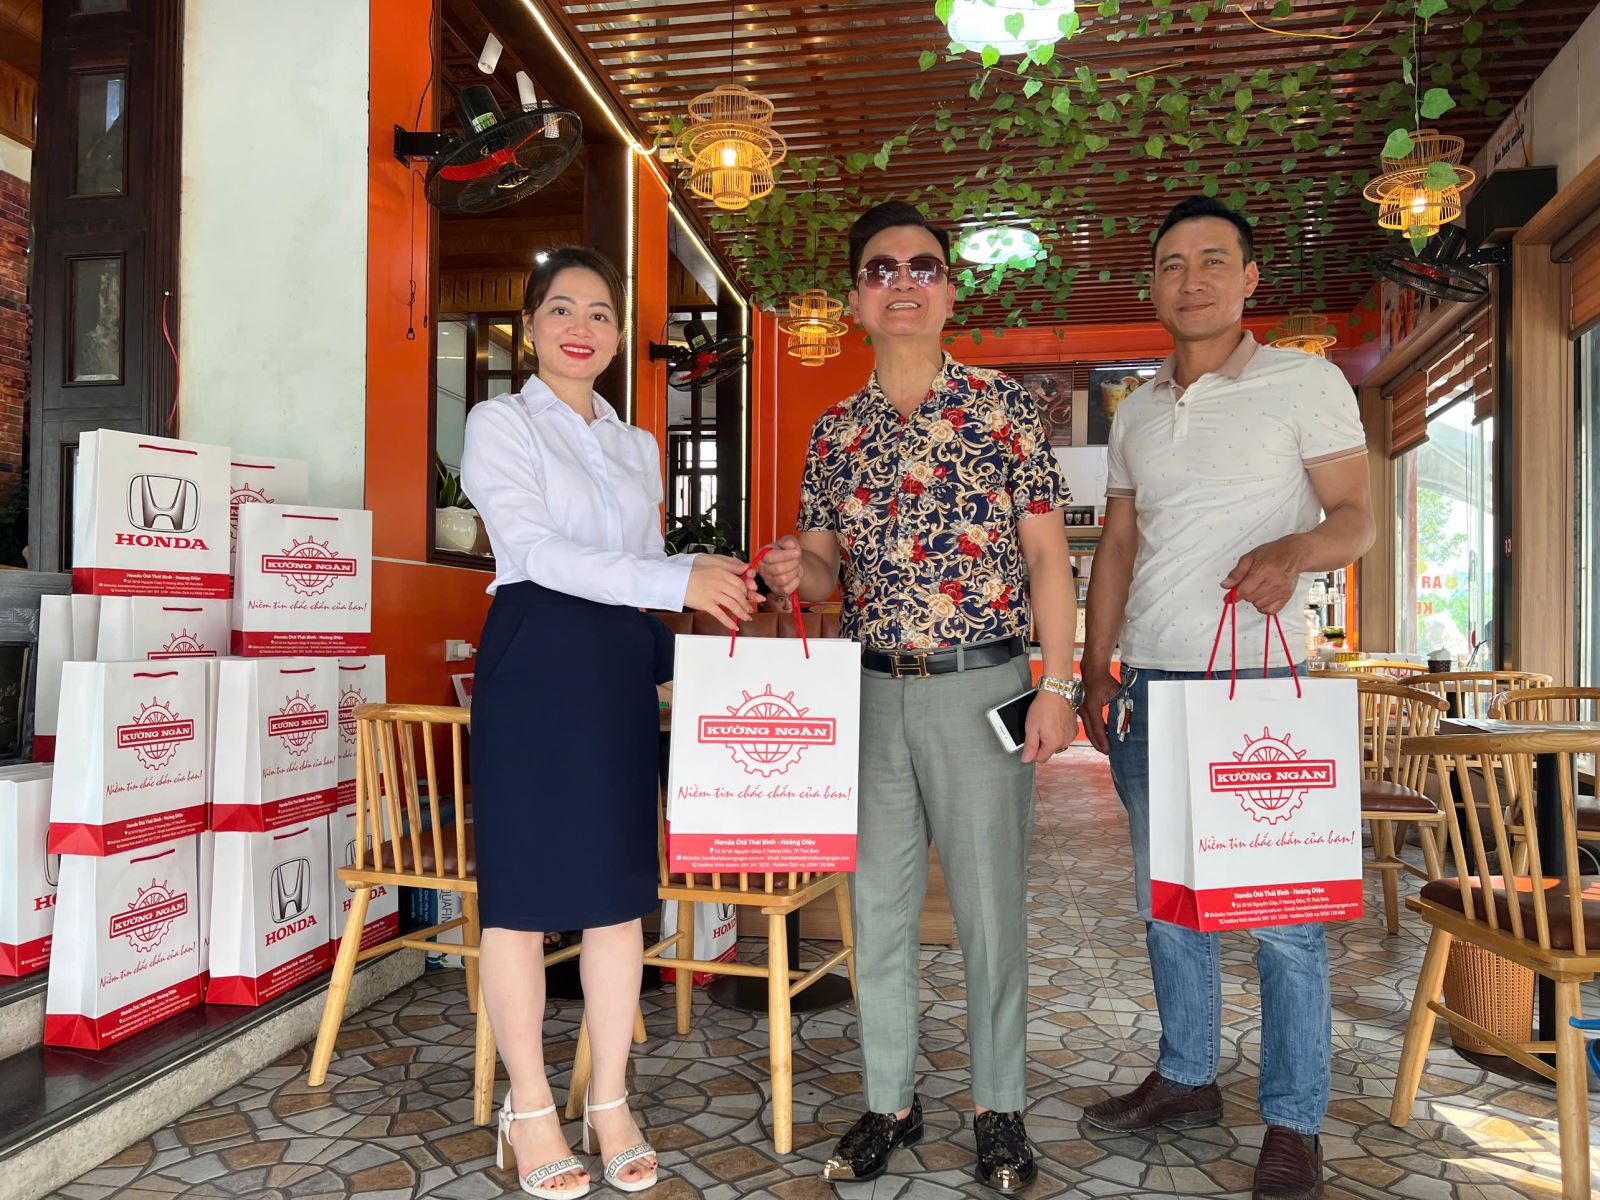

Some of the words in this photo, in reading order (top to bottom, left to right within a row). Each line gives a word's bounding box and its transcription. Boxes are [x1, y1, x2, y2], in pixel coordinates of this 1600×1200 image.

[115, 533, 209, 550] HONDA
[268, 561, 312, 569] KƯỜNG
[706, 724, 770, 735] KƯỜNG
[775, 725, 827, 736] NGÂN
[1217, 770, 1272, 783] KƯỜNG
[1276, 769, 1327, 781] NGÂN
[677, 784, 711, 800] Niềm
[714, 787, 735, 799] tin
[737, 784, 764, 799] chắc
[767, 784, 796, 799] chắn
[800, 786, 820, 799] của
[1199, 836, 1226, 853] Niềm
[1228, 837, 1247, 850] tin
[1250, 832, 1273, 848] chắc
[1276, 831, 1301, 847] chắn
[1304, 832, 1324, 845] của
[343, 886, 387, 912] HDA
[265, 914, 317, 946] HONDA
